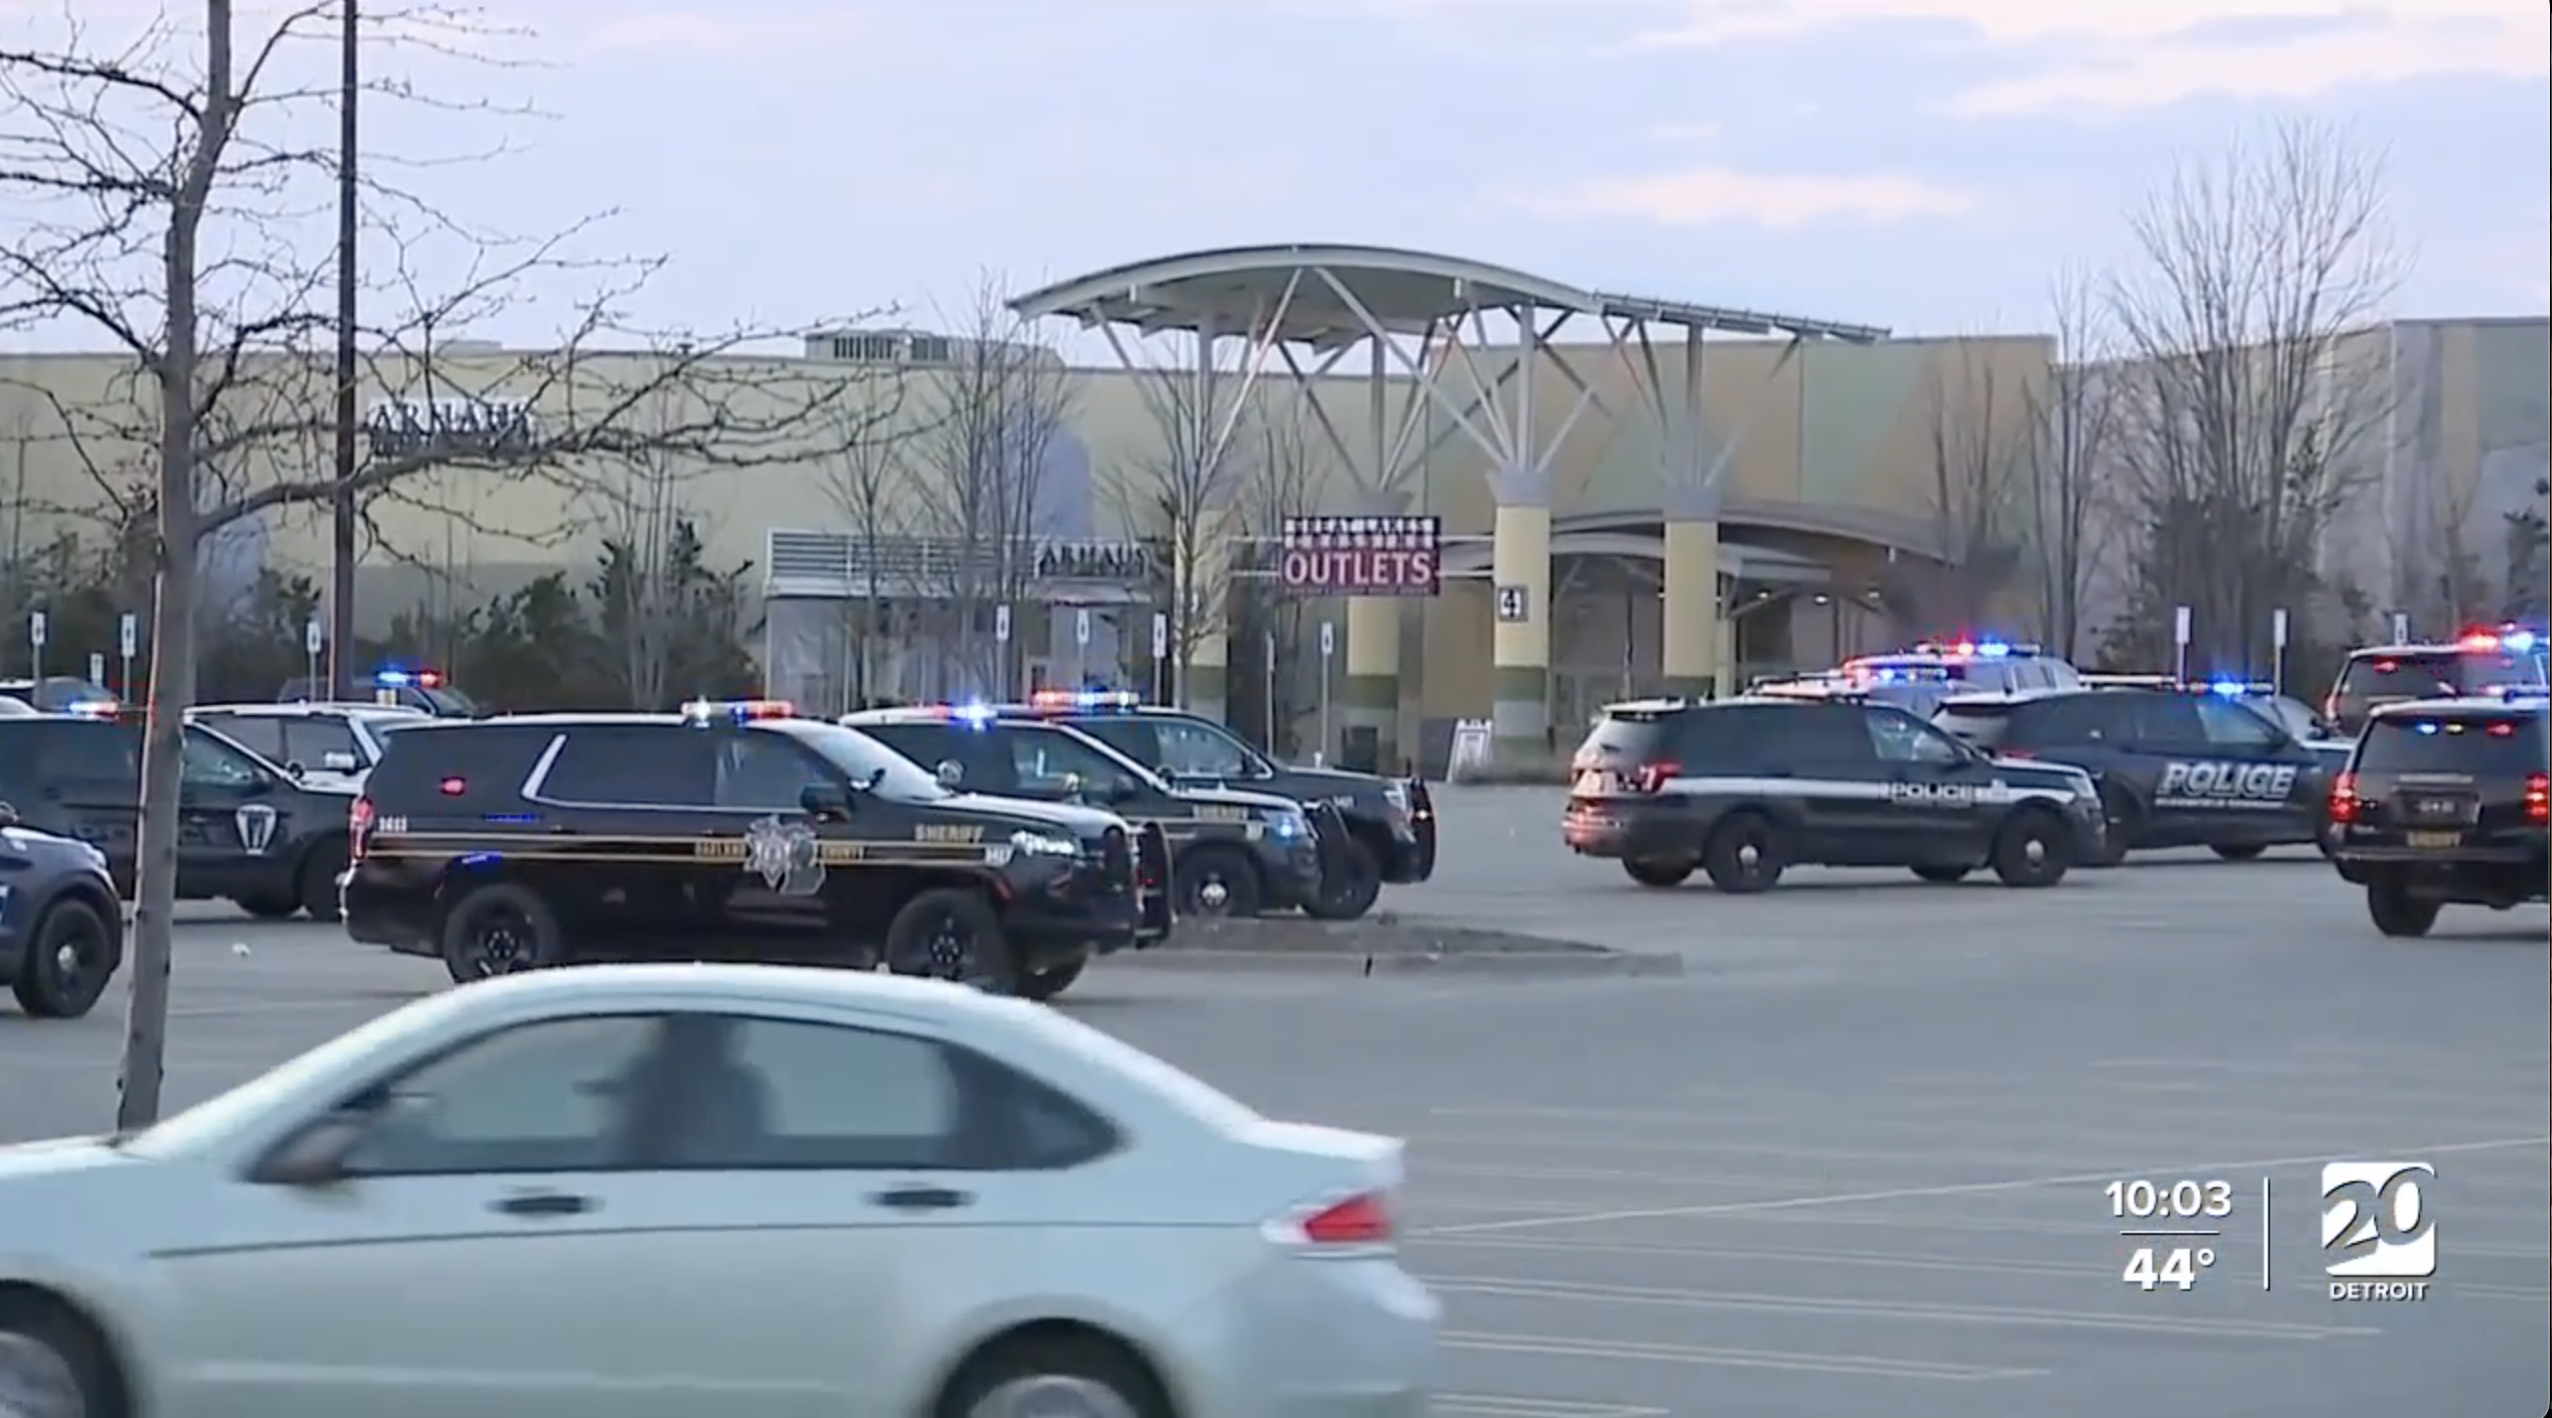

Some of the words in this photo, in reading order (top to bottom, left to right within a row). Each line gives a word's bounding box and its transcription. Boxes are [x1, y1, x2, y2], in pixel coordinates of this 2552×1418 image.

[1285, 551, 1431, 585] OUTLETS
[1891, 782, 1972, 802] POLICE
[2155, 760, 2298, 798] POLICE
